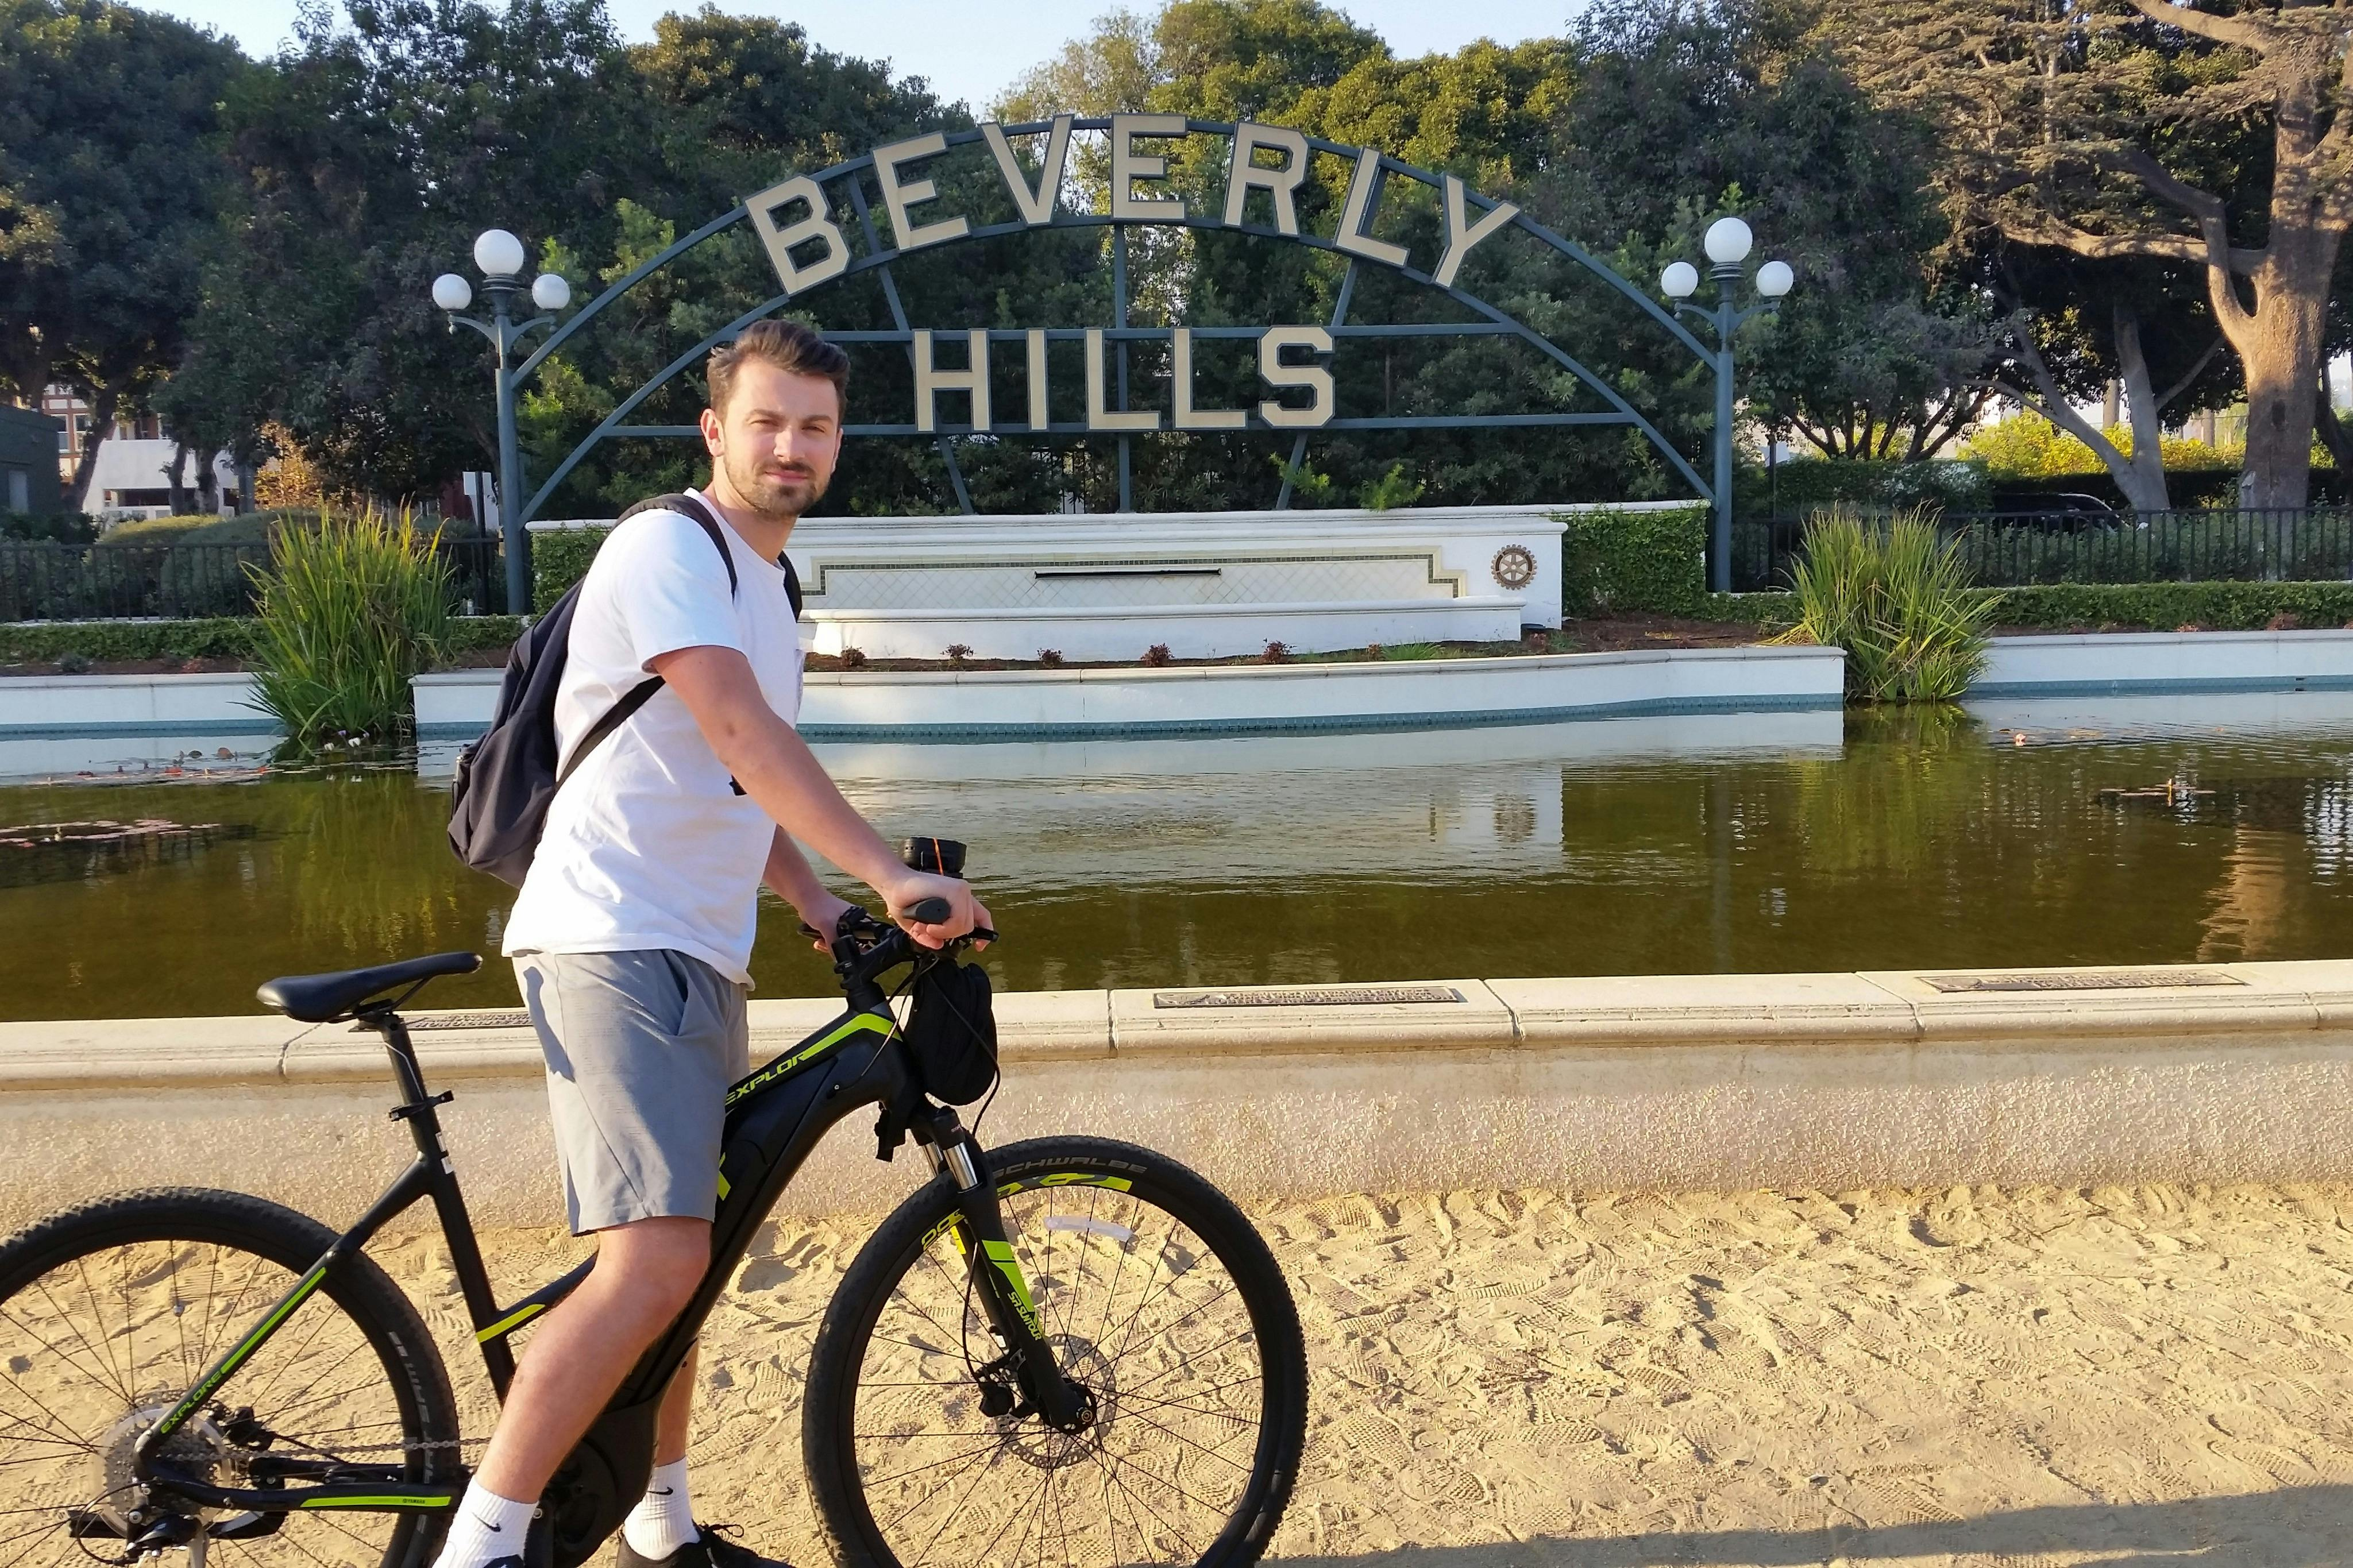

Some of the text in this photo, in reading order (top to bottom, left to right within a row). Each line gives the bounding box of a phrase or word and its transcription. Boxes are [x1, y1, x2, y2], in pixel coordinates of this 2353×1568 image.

[745, 113, 1520, 297] BEVERLY
[913, 325, 1337, 433] HILLS
[993, 1156, 1147, 1179] SCHWALBE
[1007, 1291, 1042, 1341] SR SUNTOUR
[160, 1370, 222, 1434] EXPLORE
